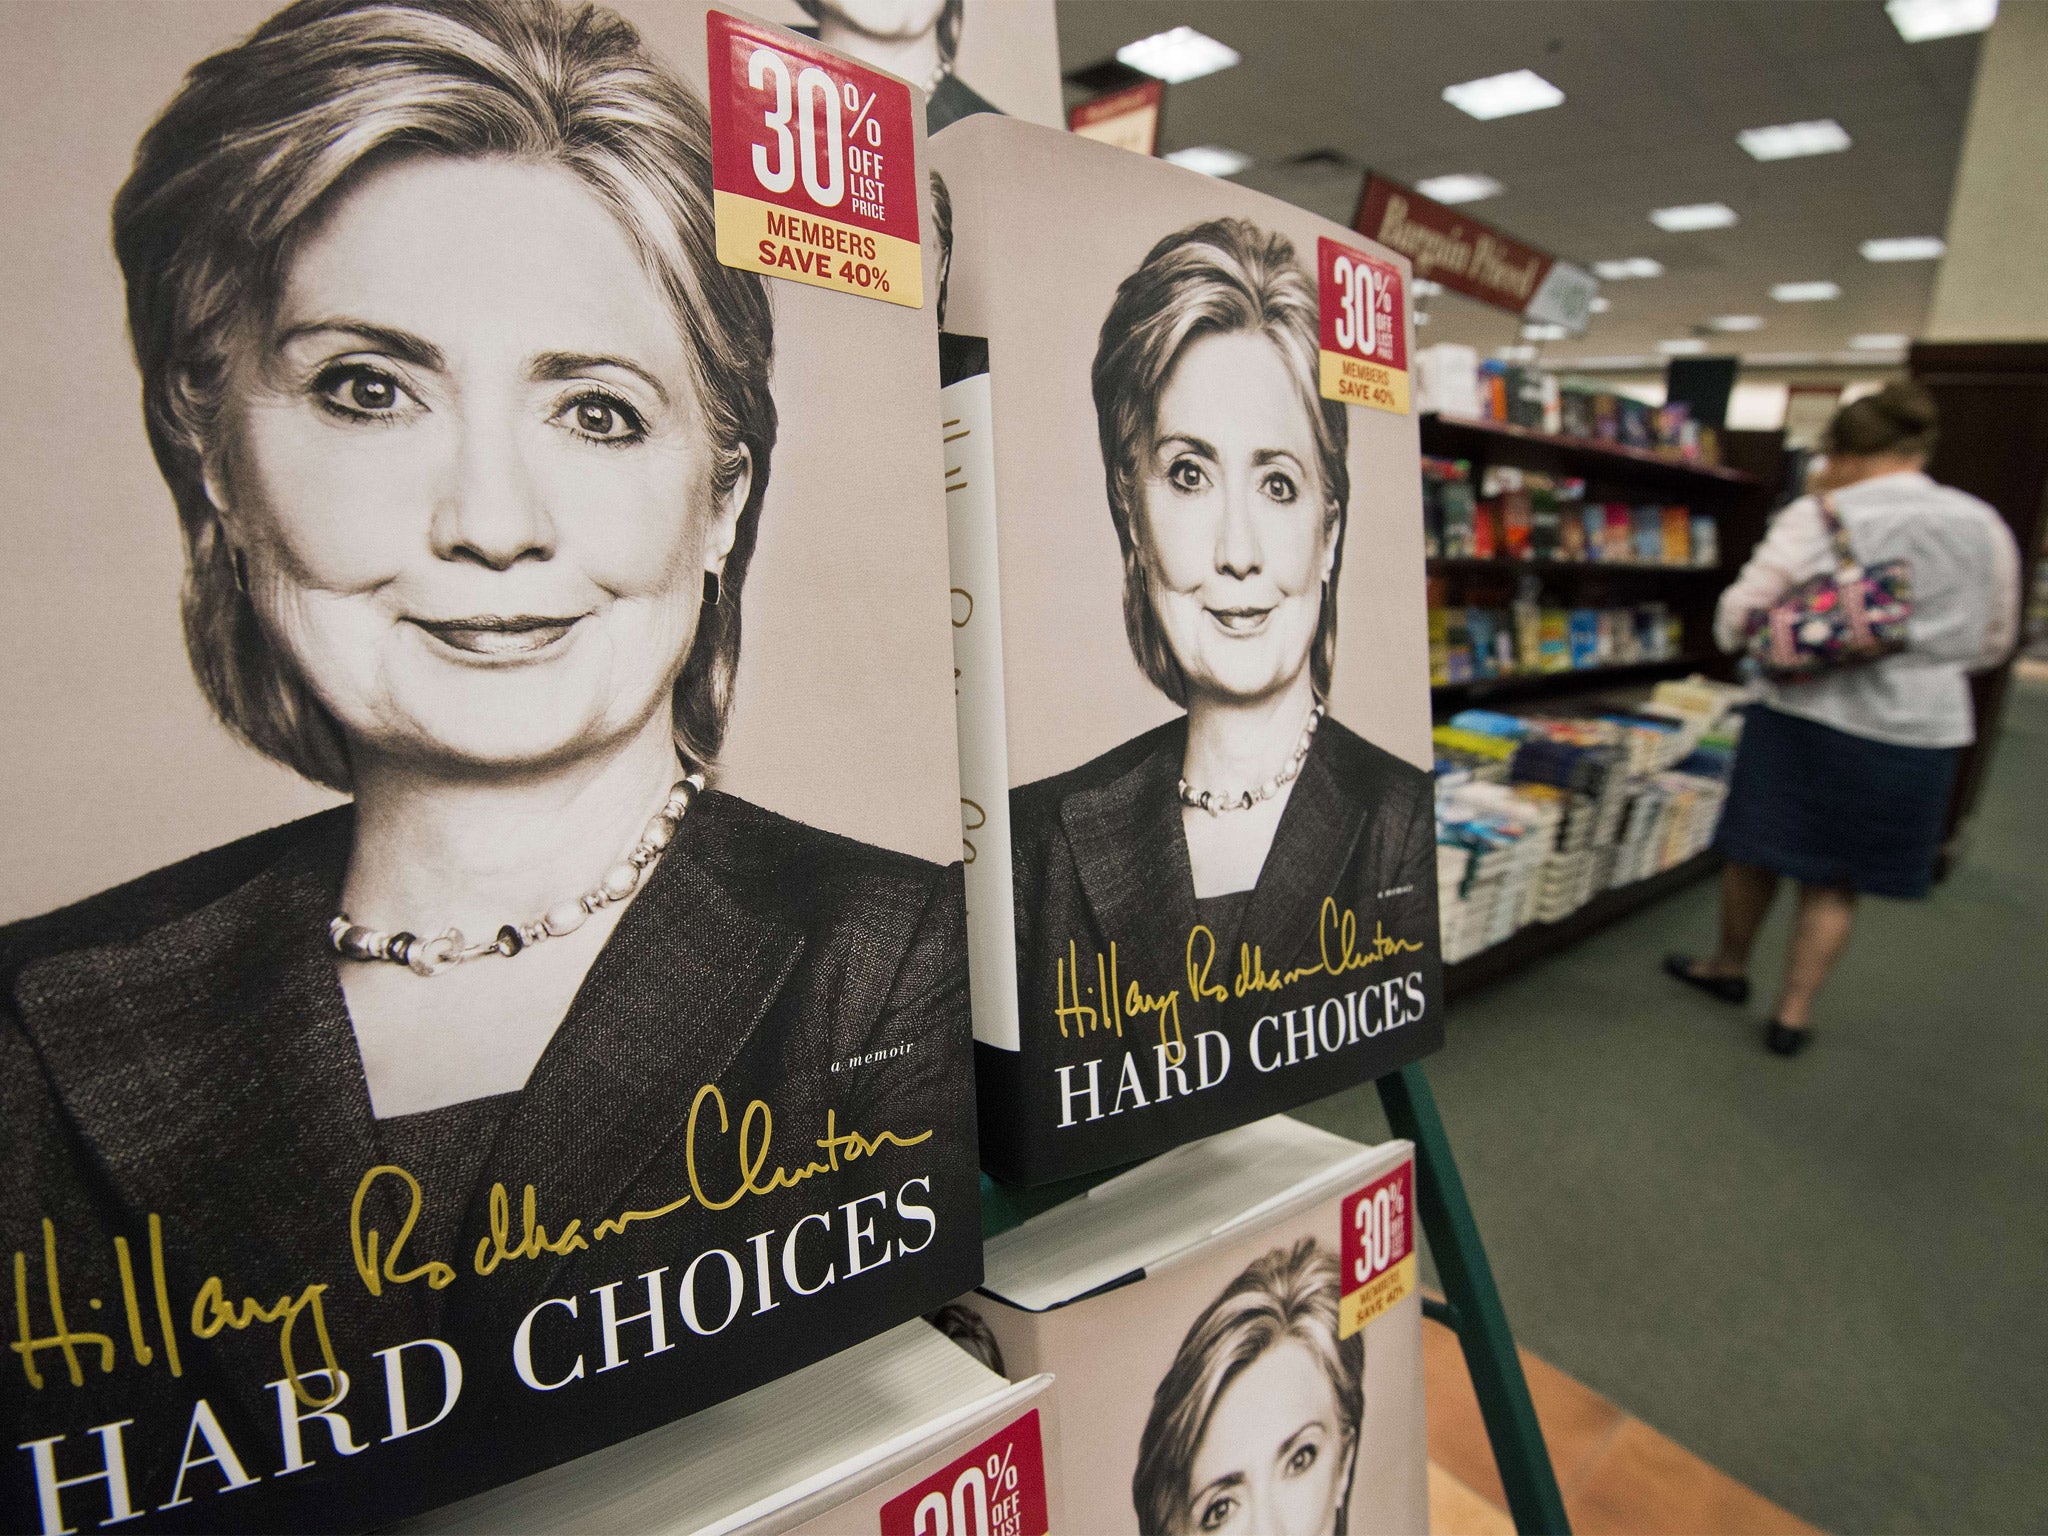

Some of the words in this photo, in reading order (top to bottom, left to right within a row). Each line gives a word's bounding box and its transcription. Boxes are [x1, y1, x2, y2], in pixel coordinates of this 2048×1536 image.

[748, 49, 881, 207] 30%
[848, 146, 884, 179] OFF
[850, 174, 885, 203] LIST
[852, 199, 886, 221] PRICE
[767, 211, 876, 260] MEMBERS
[759, 240, 832, 279] SAVE
[839, 261, 890, 292] 40%
[1334, 256, 1392, 356] 30%
[1339, 378, 1370, 400] SAVE
[1373, 387, 1395, 406] 40%
[1342, 360, 1390, 386] MEMBERS
[1055, 939, 1180, 1065] Hillary
[1187, 925, 1323, 1002] Rodham
[1320, 896, 1424, 976] Clinton
[831, 1061, 840, 1073] a
[849, 1040, 914, 1068] memoir
[1054, 1030, 1231, 1128] HARD
[1249, 971, 1426, 1073] CHOICES
[10, 1212, 329, 1407] Hillary
[350, 1164, 691, 1296] Rodham
[686, 1083, 933, 1211] Clinton
[1354, 1178, 1405, 1284] 30%
[17, 1338, 463, 1536] HARD
[512, 1175, 937, 1391] CHOICES
[992, 1490, 1019, 1526] OFF
